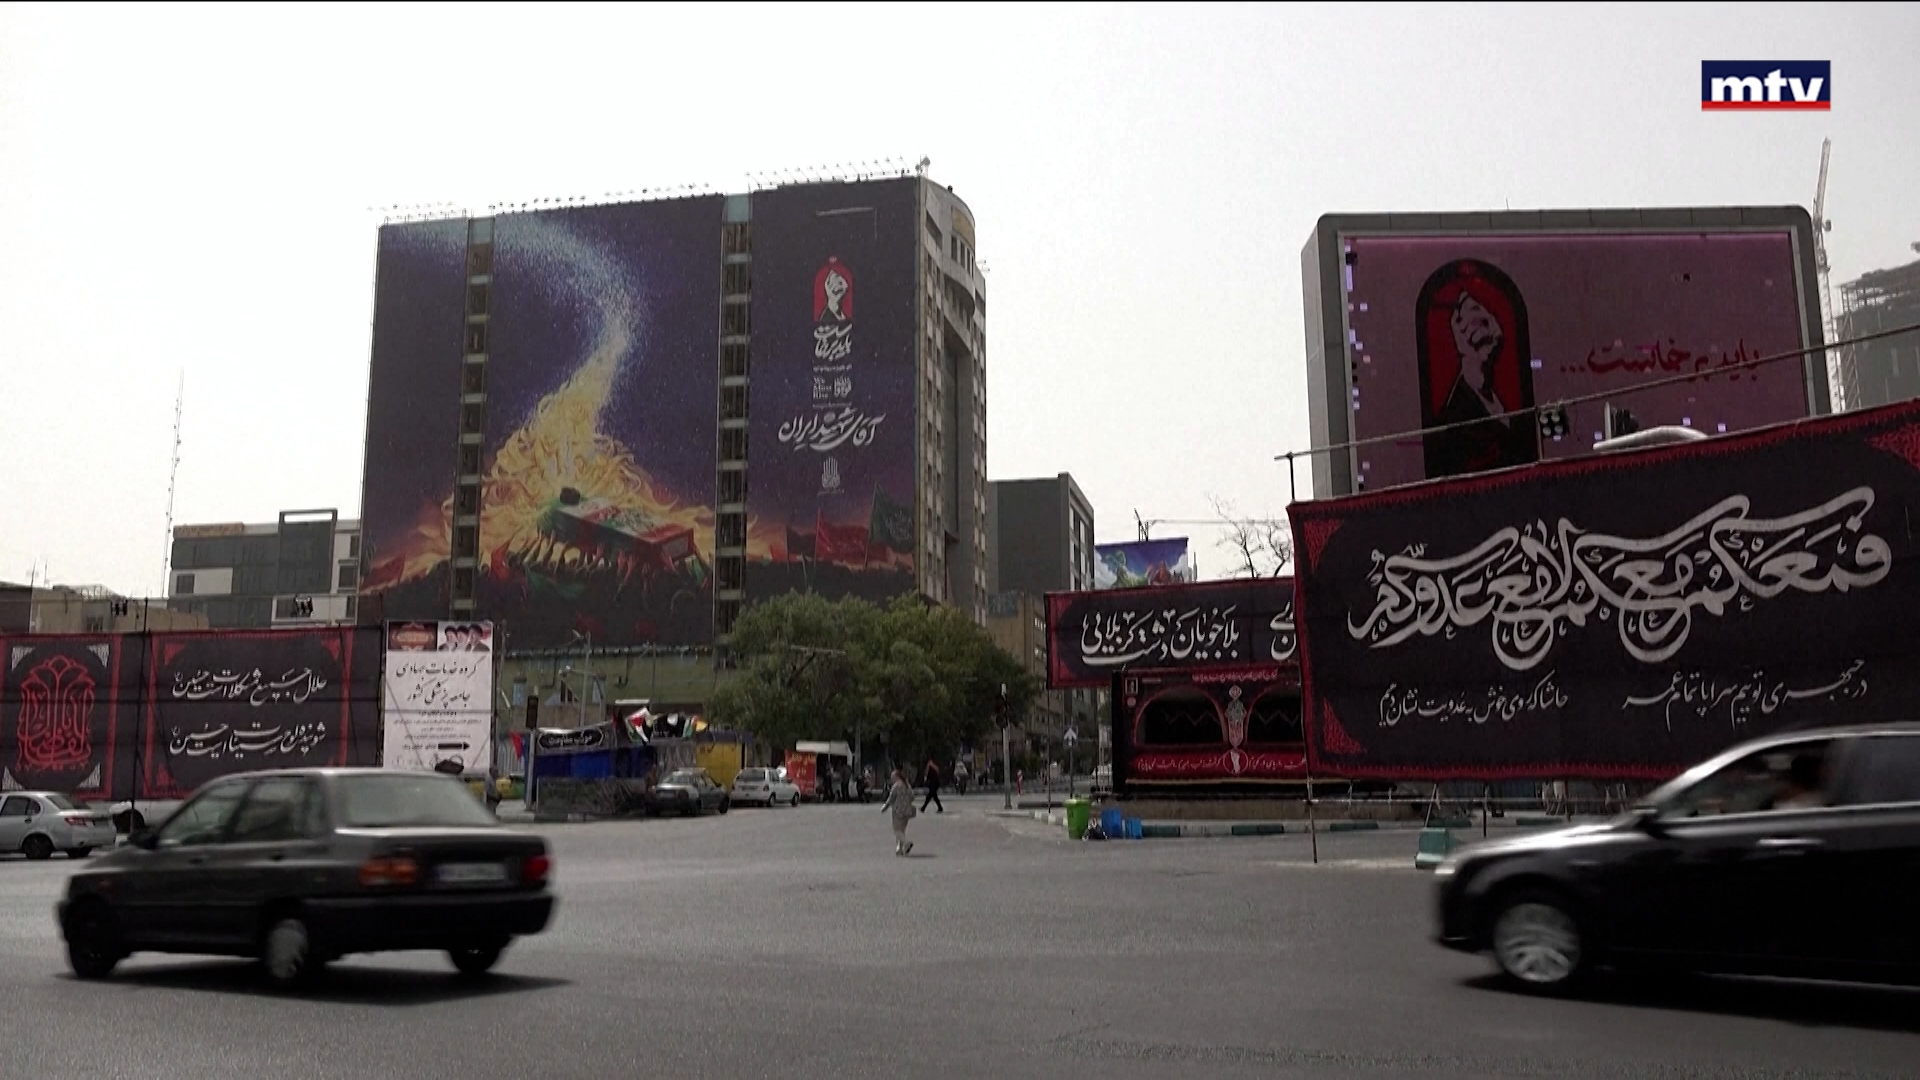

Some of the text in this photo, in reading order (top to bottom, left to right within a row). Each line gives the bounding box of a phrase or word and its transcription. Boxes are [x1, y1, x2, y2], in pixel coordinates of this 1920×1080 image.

[778, 412, 819, 452] ایران
[1080, 608, 1155, 655] کربلایی
[1082, 617, 1168, 666] دشت
[1170, 603, 1240, 661] بلاجویان
[426, 661, 458, 675] خدمات
